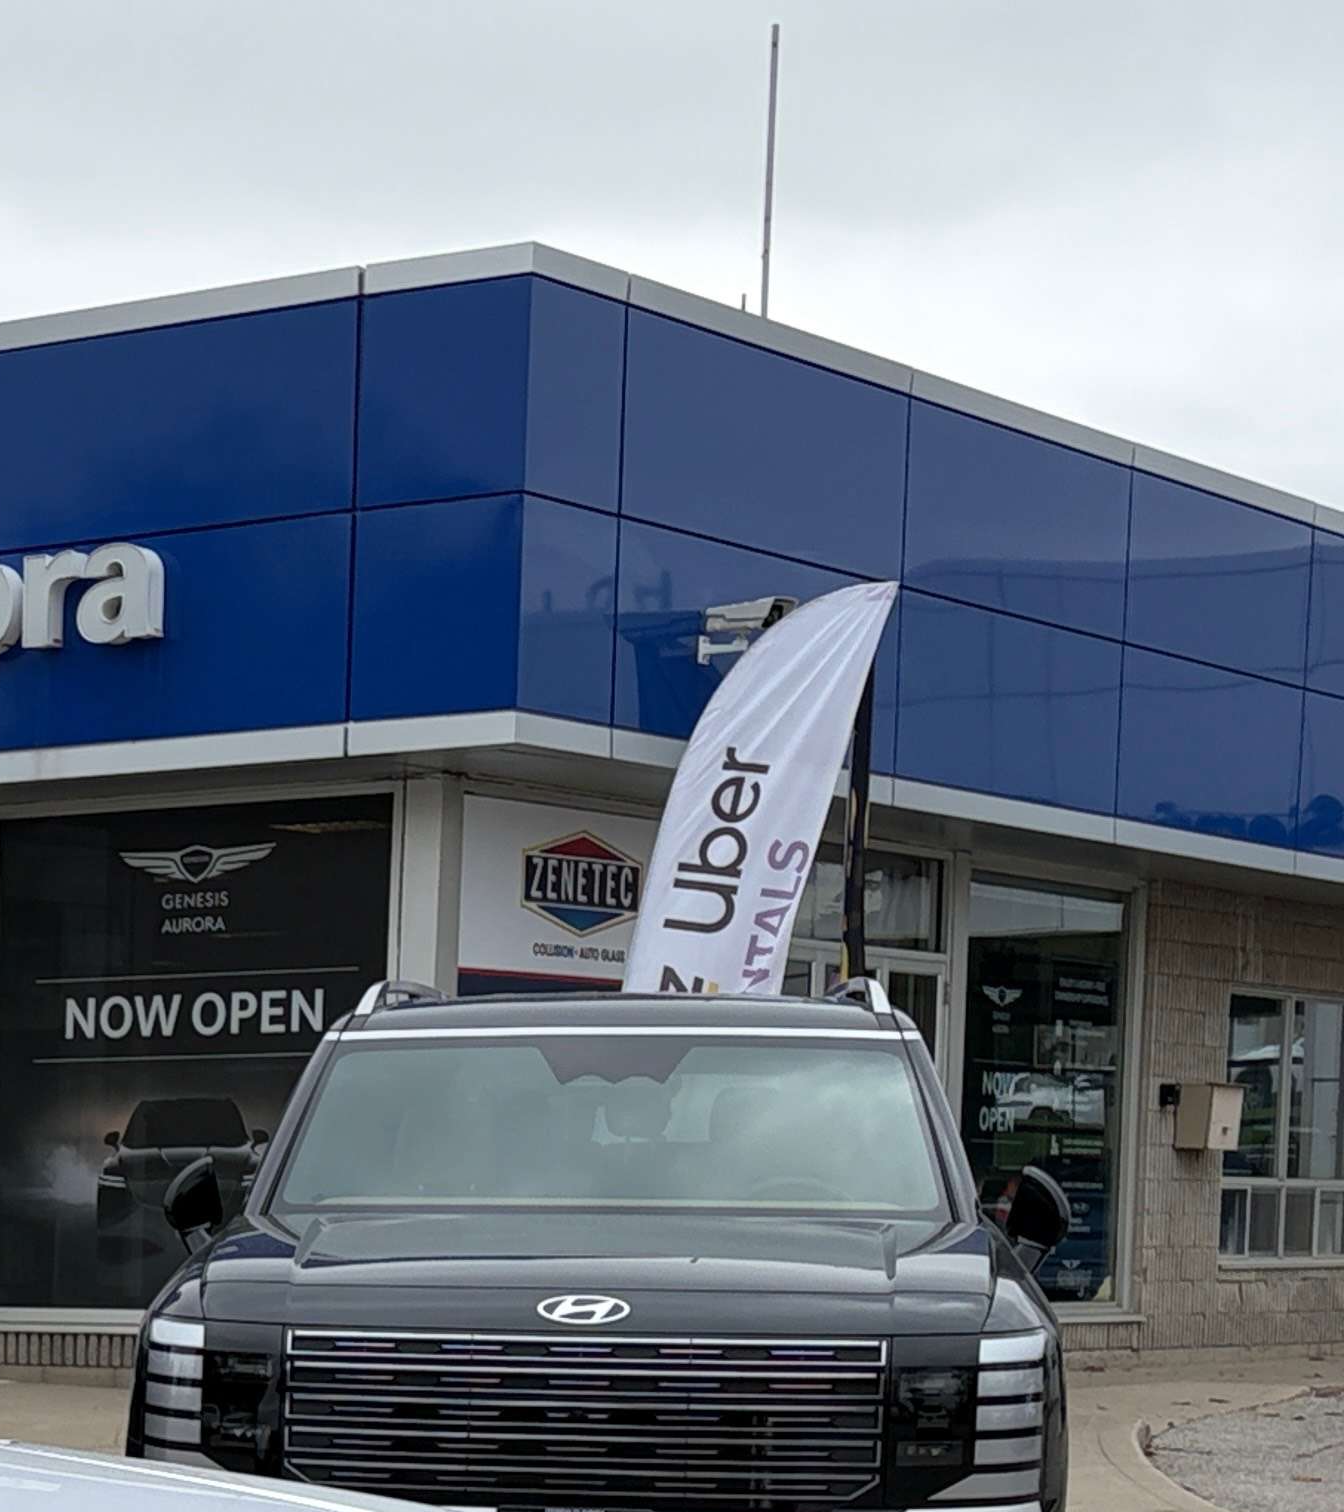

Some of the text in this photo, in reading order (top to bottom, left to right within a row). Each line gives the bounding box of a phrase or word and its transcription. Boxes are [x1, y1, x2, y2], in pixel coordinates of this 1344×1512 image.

[663, 747, 770, 934] Uber
[161, 891, 229, 910] GENESIS
[530, 857, 633, 908] ZENETEC
[161, 915, 226, 934] AURORA
[65, 989, 325, 1040] NOW OPEN
[979, 1106, 1016, 1133] OPEN
